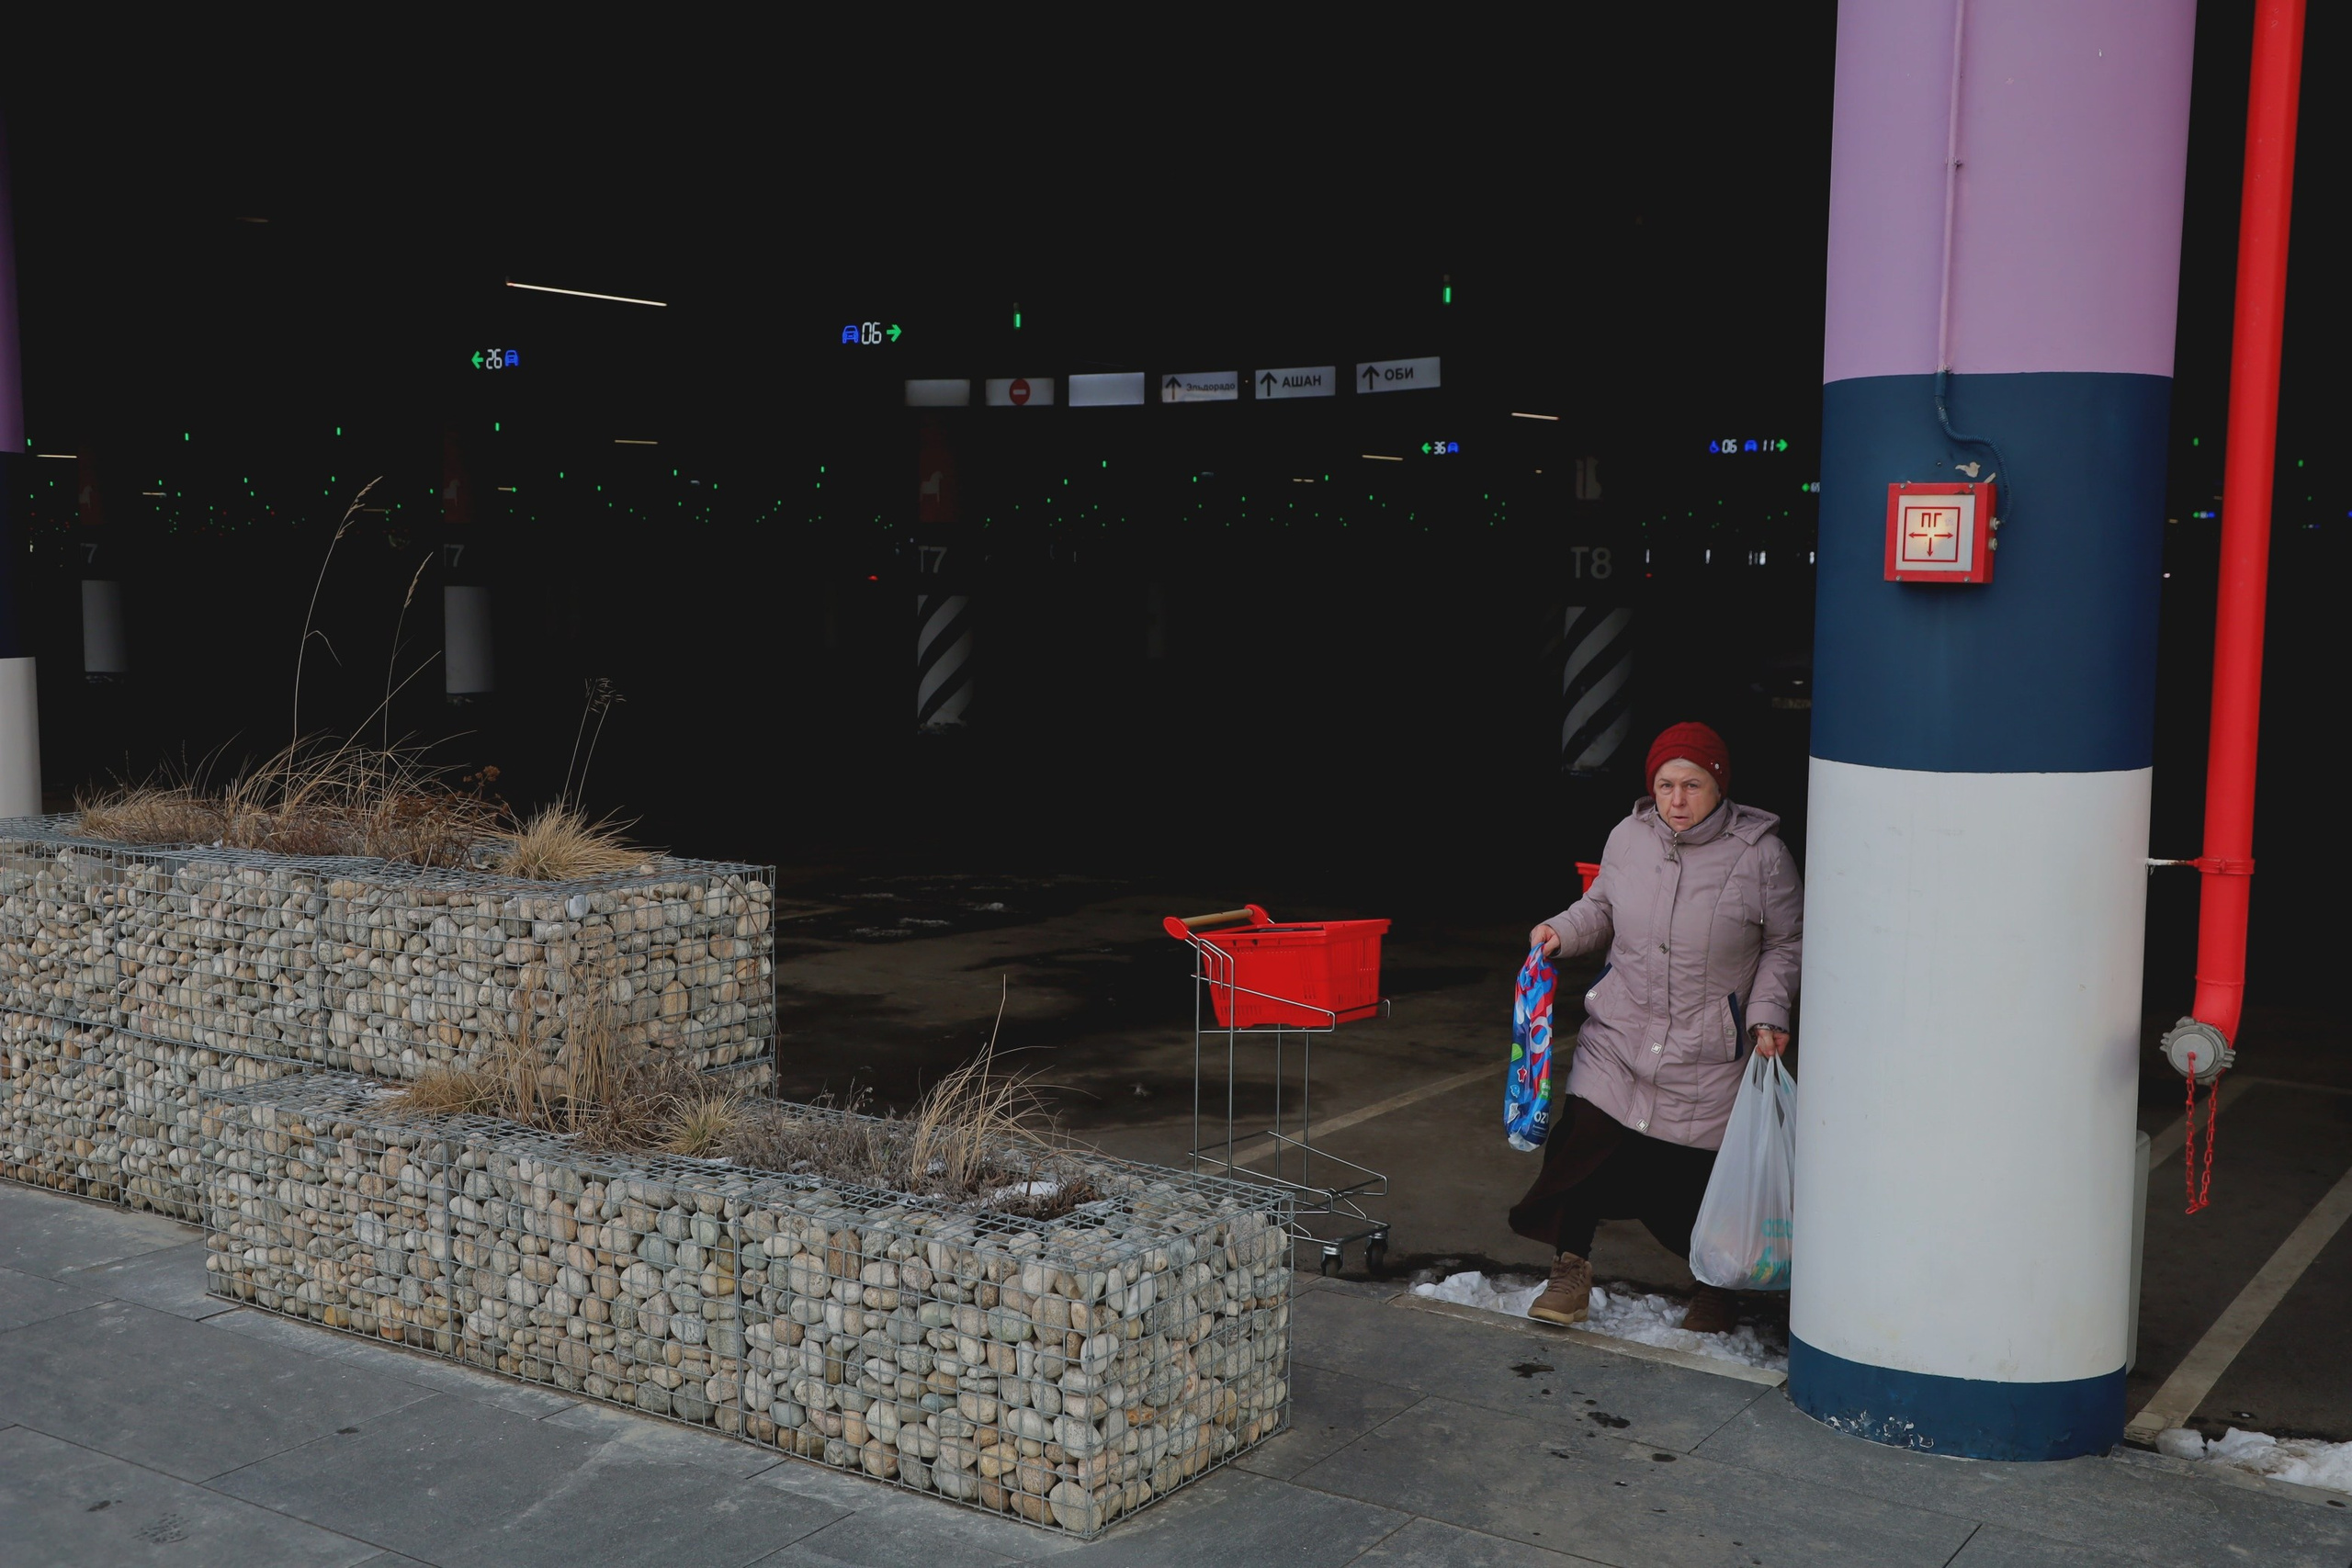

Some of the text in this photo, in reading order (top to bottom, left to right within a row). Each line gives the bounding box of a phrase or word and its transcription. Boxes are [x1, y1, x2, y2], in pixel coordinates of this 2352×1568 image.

[861, 321, 882, 344] 06
[485, 348, 503, 369] 26
[1282, 374, 1322, 388] АШАН
[1384, 367, 1414, 381] ОБИ
[1186, 382, 1236, 392] Эльдорадо
[1433, 441, 1446, 455] 36
[1721, 439, 1738, 454] 06
[1921, 512, 1942, 528] ПГ
[918, 545, 948, 574] T7
[1569, 546, 1612, 580] T8
